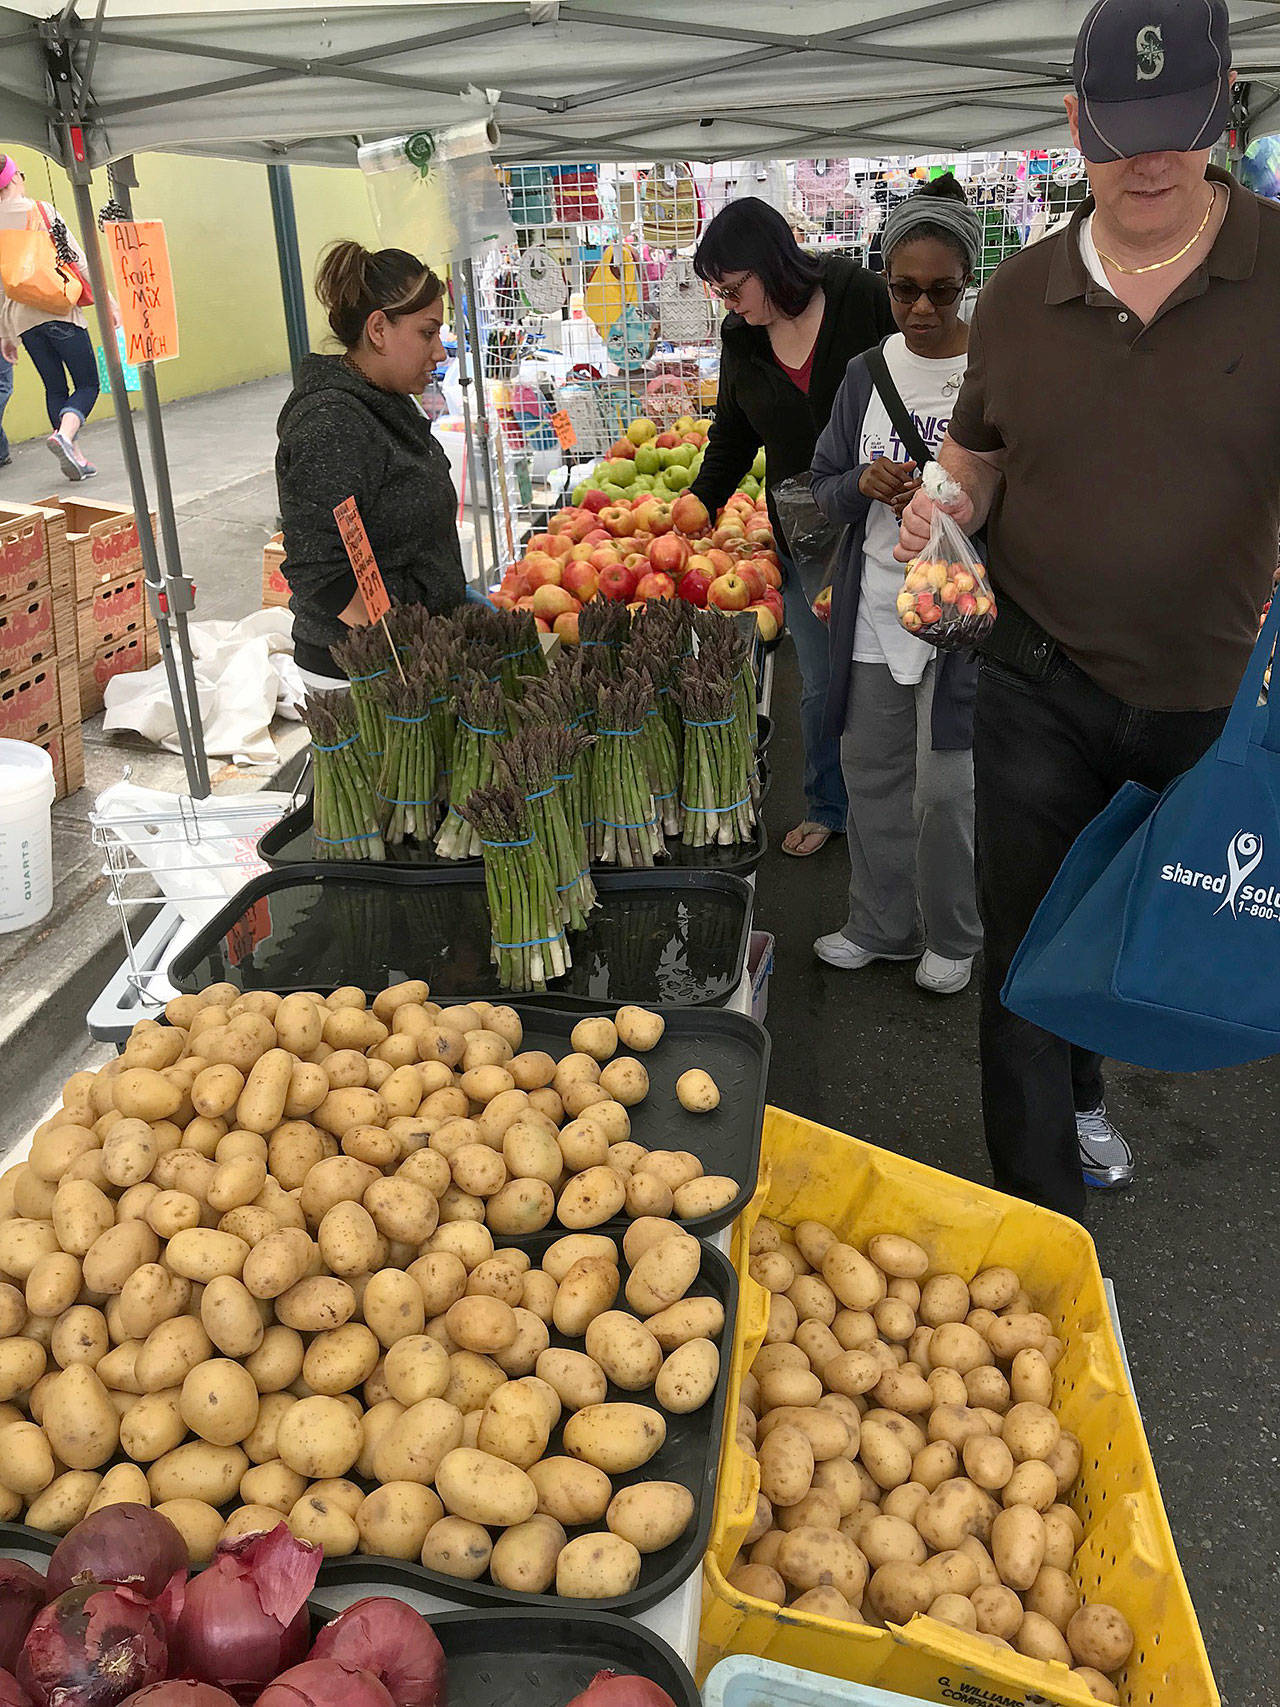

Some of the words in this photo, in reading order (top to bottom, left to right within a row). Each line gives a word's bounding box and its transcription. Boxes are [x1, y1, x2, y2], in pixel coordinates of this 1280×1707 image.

[114, 224, 149, 250] ALL
[121, 255, 155, 287] fruit
[21, 840, 32, 900] QUARTS
[1160, 862, 1227, 894] shared
